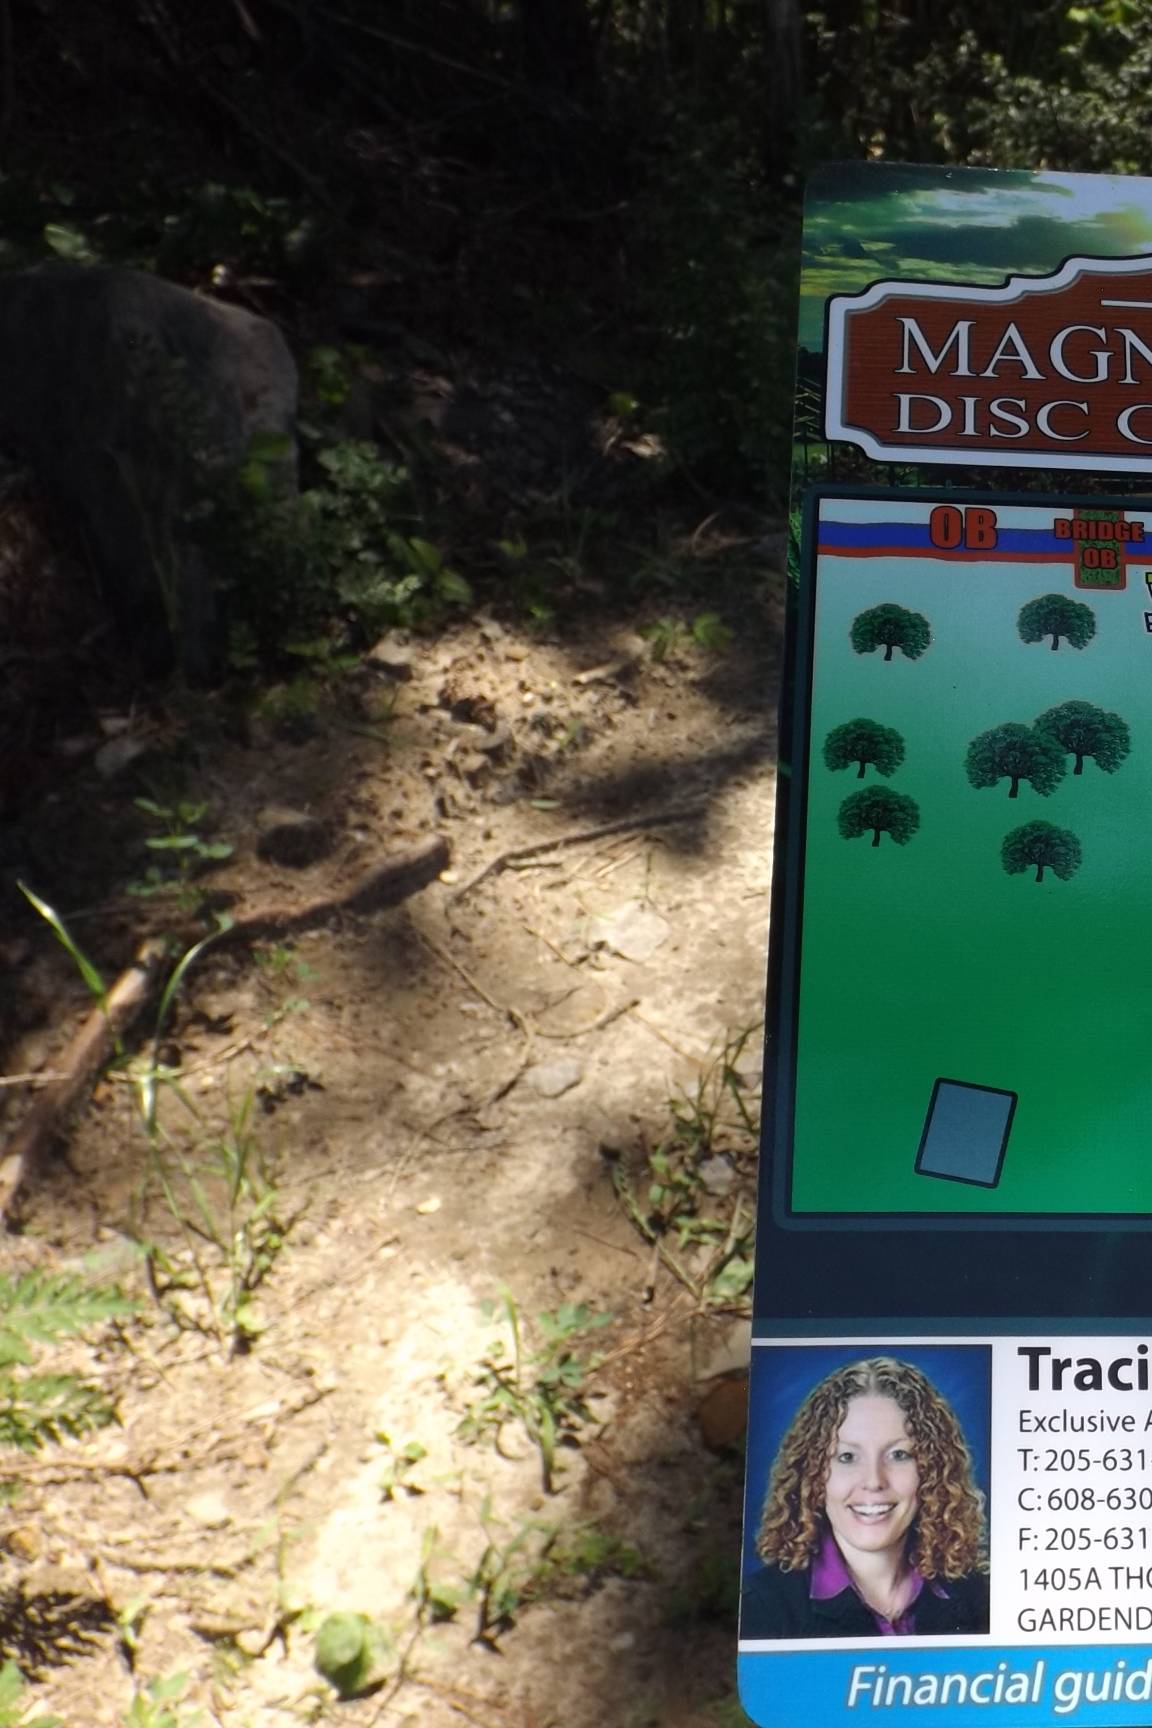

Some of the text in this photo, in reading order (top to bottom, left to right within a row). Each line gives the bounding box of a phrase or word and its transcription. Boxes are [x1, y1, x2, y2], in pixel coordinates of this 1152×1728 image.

[893, 392, 1091, 442] DISC
[930, 505, 998, 549] OB
[1054, 518, 1145, 543] BRIDGE
[1082, 547, 1118, 569] OB
[1016, 1344, 1149, 1391] Traci
[1019, 1408, 1136, 1433] Exclusive
[1017, 1448, 1039, 1472] T:
[1017, 1487, 1041, 1512] C:
[1018, 1527, 1038, 1551] F:
[1020, 1566, 1102, 1591] 1405A
[846, 1661, 1042, 1708] Financial
